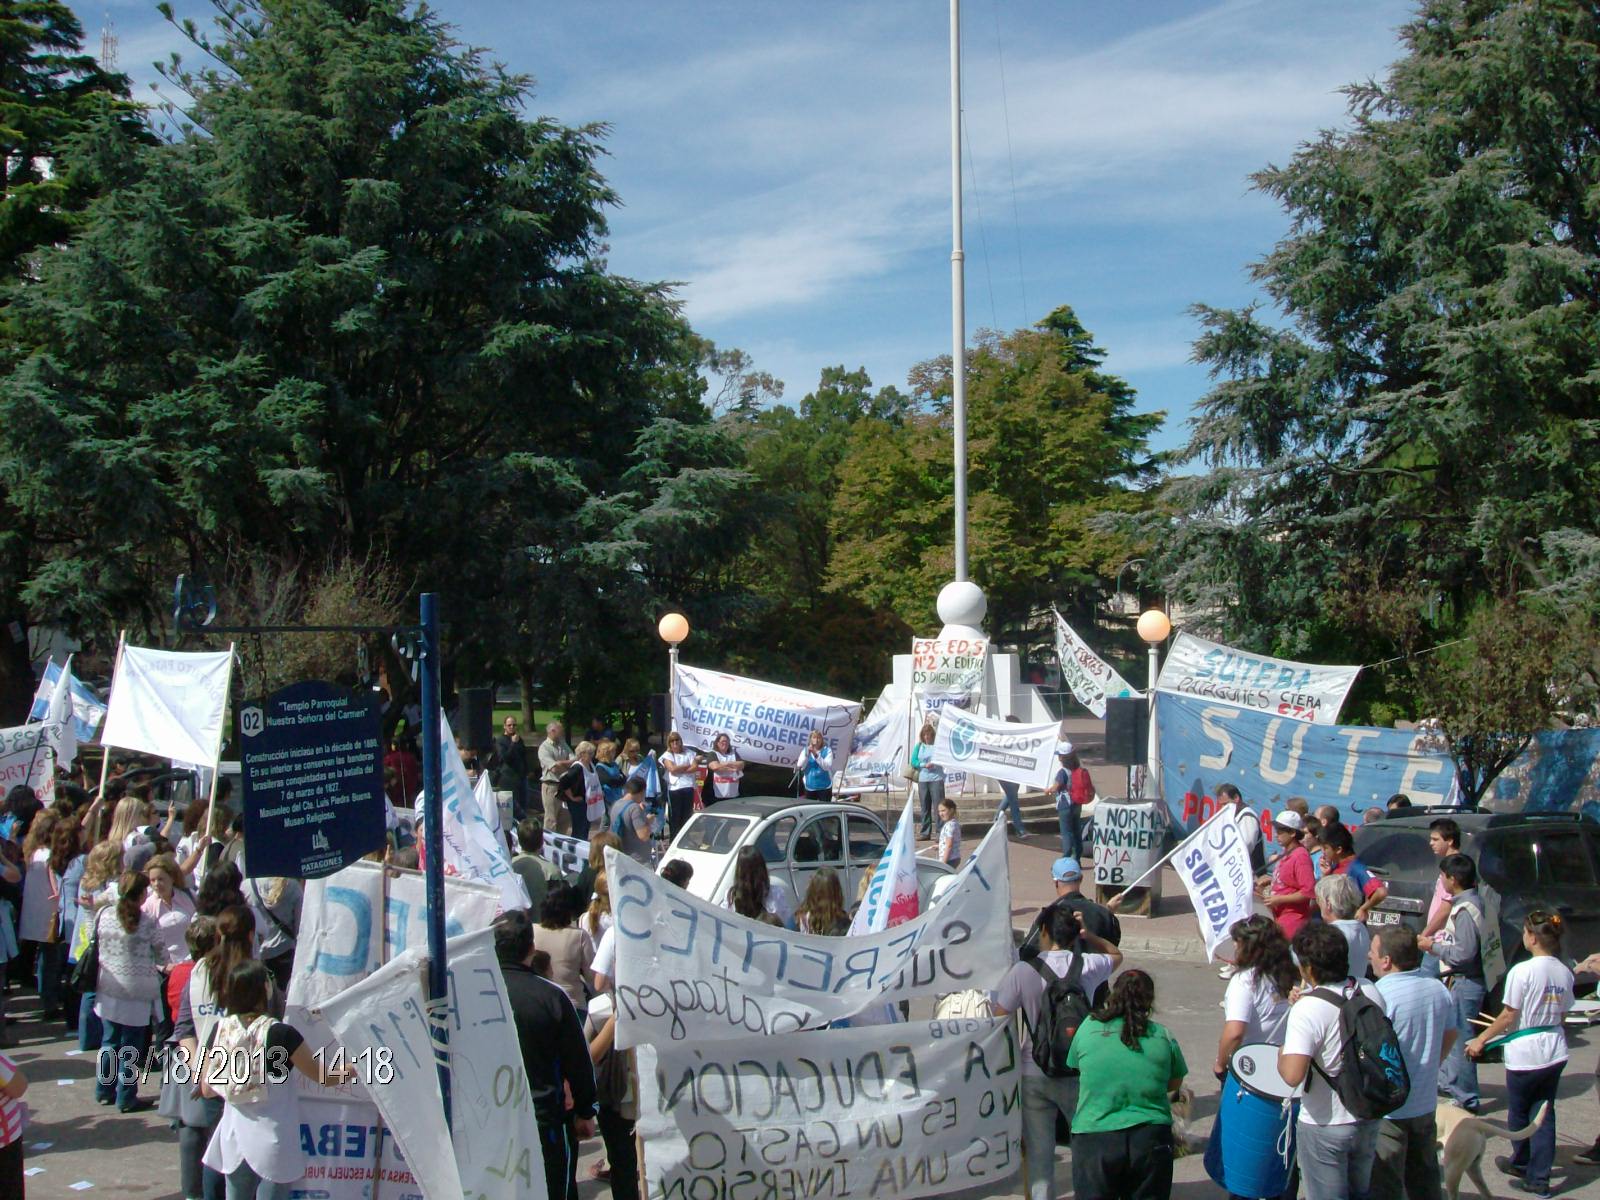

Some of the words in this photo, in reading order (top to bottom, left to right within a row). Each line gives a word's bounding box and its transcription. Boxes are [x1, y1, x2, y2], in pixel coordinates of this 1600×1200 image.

[1196, 648, 1311, 690] SUTEBA
[311, 697, 348, 710] Parroquial
[1279, 691, 1322, 710] CTERA
[243, 712, 260, 730] 02
[266, 715, 296, 727] Nuestra
[298, 712, 324, 724] Señora
[325, 711, 336, 721] del
[754, 704, 817, 731] GREMIAL
[1277, 703, 1315, 721] CTA
[733, 734, 785, 752] SADOP
[737, 718, 839, 751] BONAERESE
[245, 750, 289, 764] Construcción
[289, 746, 315, 758] iniciada
[315, 745, 324, 754] en
[324, 744, 332, 753] la
[331, 741, 354, 752] década
[354, 740, 362, 750] de
[250, 767, 260, 778] En
[260, 767, 271, 776] su
[270, 763, 293, 775] interior
[294, 763, 303, 771] se
[303, 758, 335, 771] conservan
[335, 756, 346, 765] las
[346, 752, 375, 764] banderas
[285, 772, 327, 786] conquistadas
[328, 772, 337, 780] en
[336, 769, 343, 778] la
[343, 766, 364, 777] batalla
[364, 763, 374, 774] del
[280, 790, 286, 801] 7
[286, 790, 295, 800] de
[296, 789, 315, 798] marzo
[316, 786, 324, 795] de
[259, 806, 291, 819] Mausoleo
[291, 803, 301, 813] del
[316, 798, 330, 808] Luis
[330, 795, 350, 806] Piedra
[283, 816, 305, 828] Museo
[301, 856, 343, 872] PATAGONES
